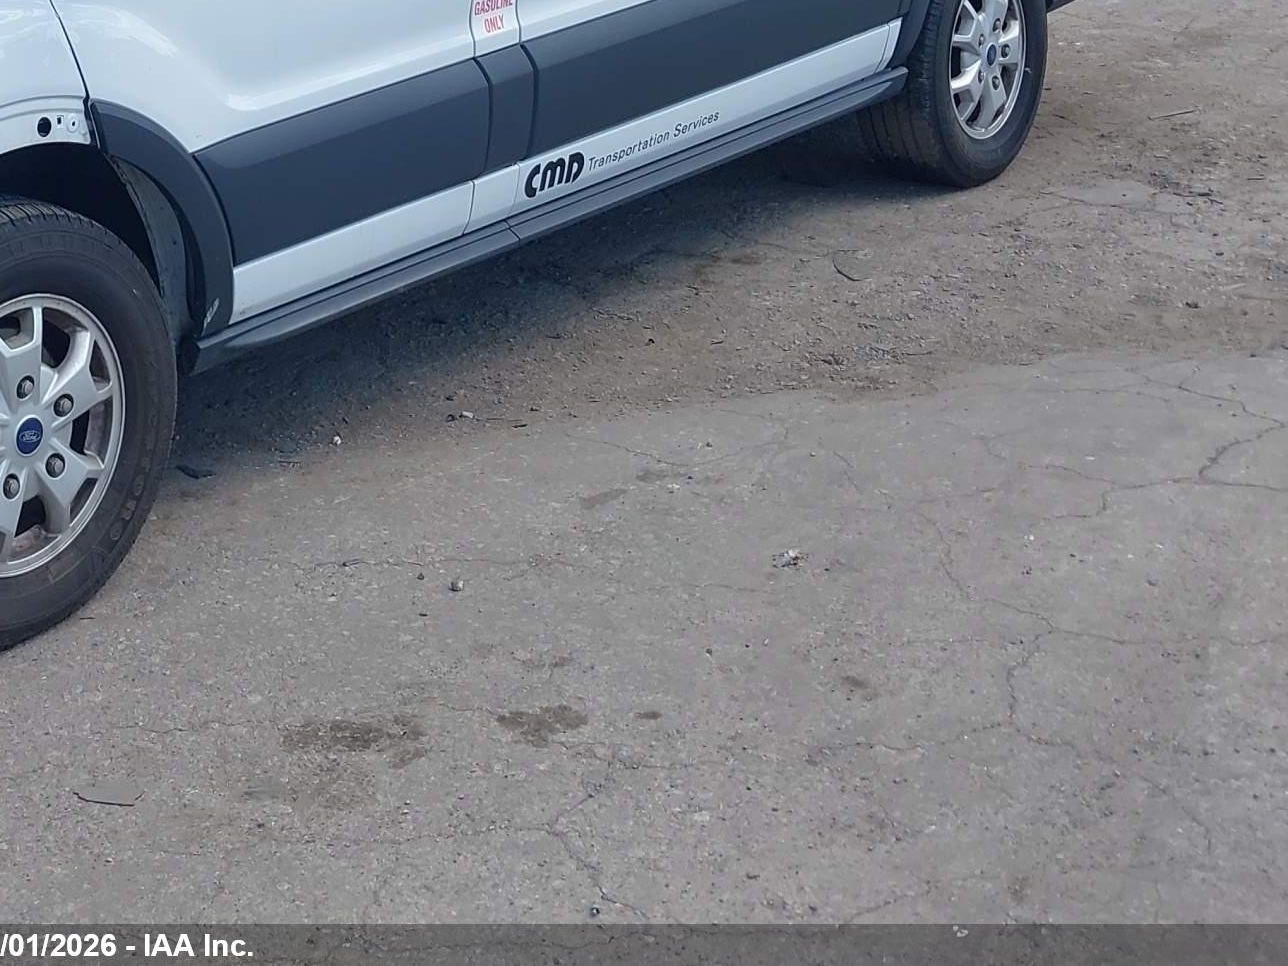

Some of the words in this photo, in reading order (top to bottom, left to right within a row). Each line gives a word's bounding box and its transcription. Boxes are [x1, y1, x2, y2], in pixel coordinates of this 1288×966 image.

[484, 14, 505, 34] ONLY
[588, 131, 670, 172] Transportation
[673, 111, 720, 138] Services
